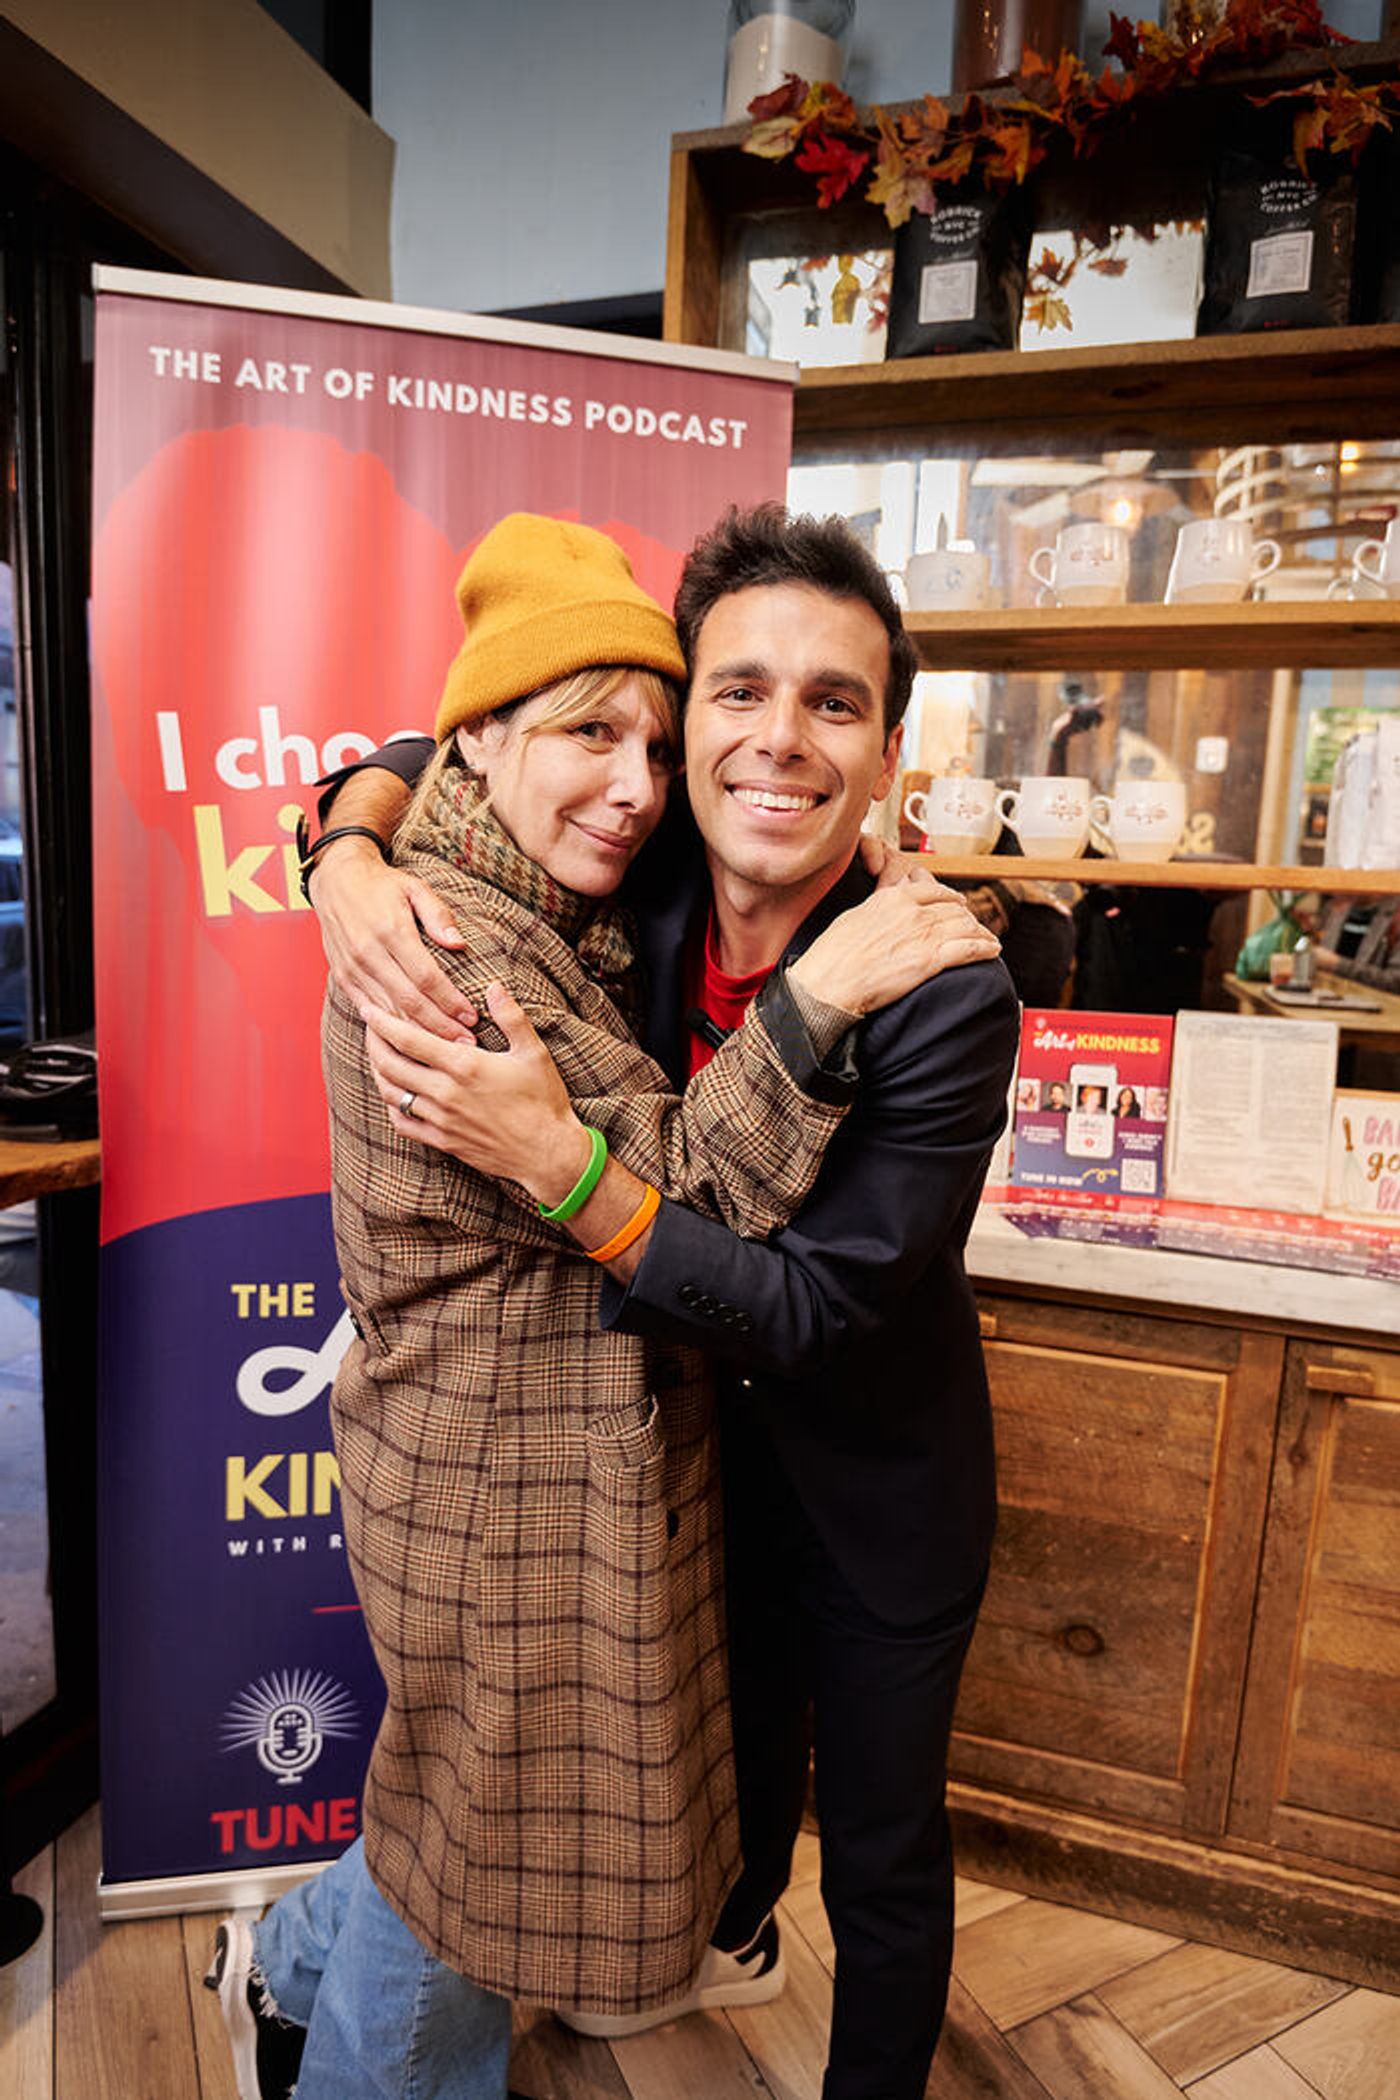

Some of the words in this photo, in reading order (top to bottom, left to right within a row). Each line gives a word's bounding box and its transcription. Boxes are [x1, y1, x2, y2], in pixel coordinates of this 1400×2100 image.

[149, 346, 221, 383] THE
[235, 357, 312, 394] ART
[324, 368, 374, 400] OF
[388, 376, 572, 427] KINDNESS
[585, 401, 747, 449] PODCAST
[156, 711, 187, 791] I
[215, 706, 428, 789] cho
[1076, 1034, 1160, 1054] KINDNESS
[231, 1282, 315, 1318] THE
[228, 1535, 306, 1556] WITH
[210, 1797, 357, 1854] TUNE
